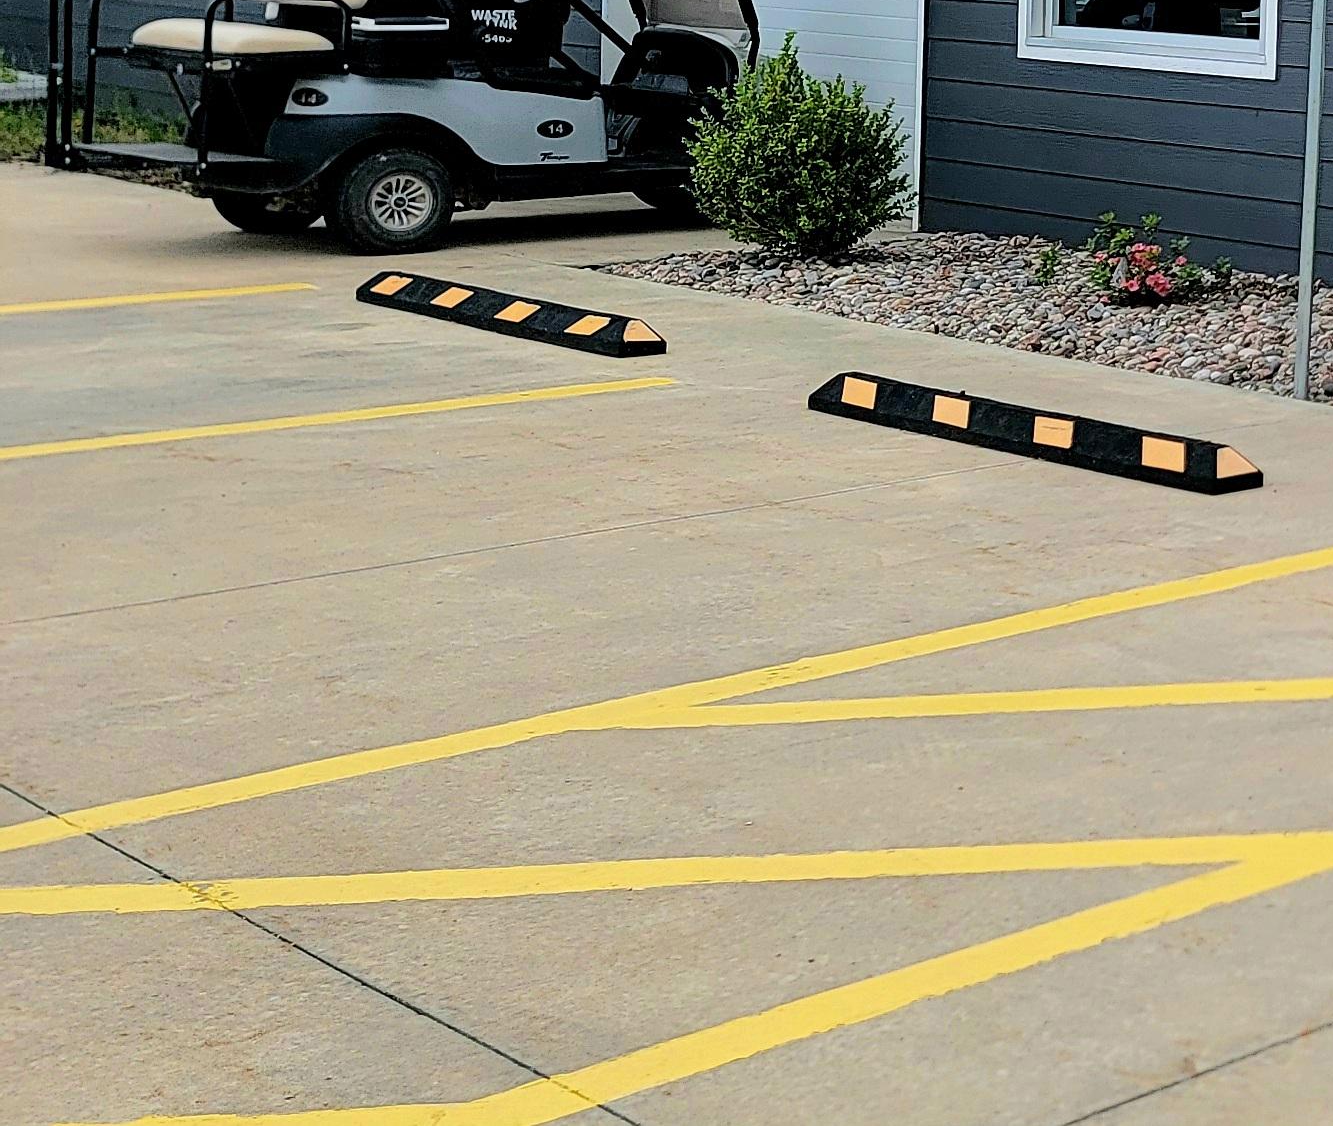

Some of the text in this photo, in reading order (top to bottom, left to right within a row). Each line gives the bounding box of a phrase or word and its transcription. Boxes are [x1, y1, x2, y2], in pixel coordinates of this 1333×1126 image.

[471, 9, 515, 21] WASTE
[301, 93, 317, 104] 14
[547, 123, 564, 134] 14
